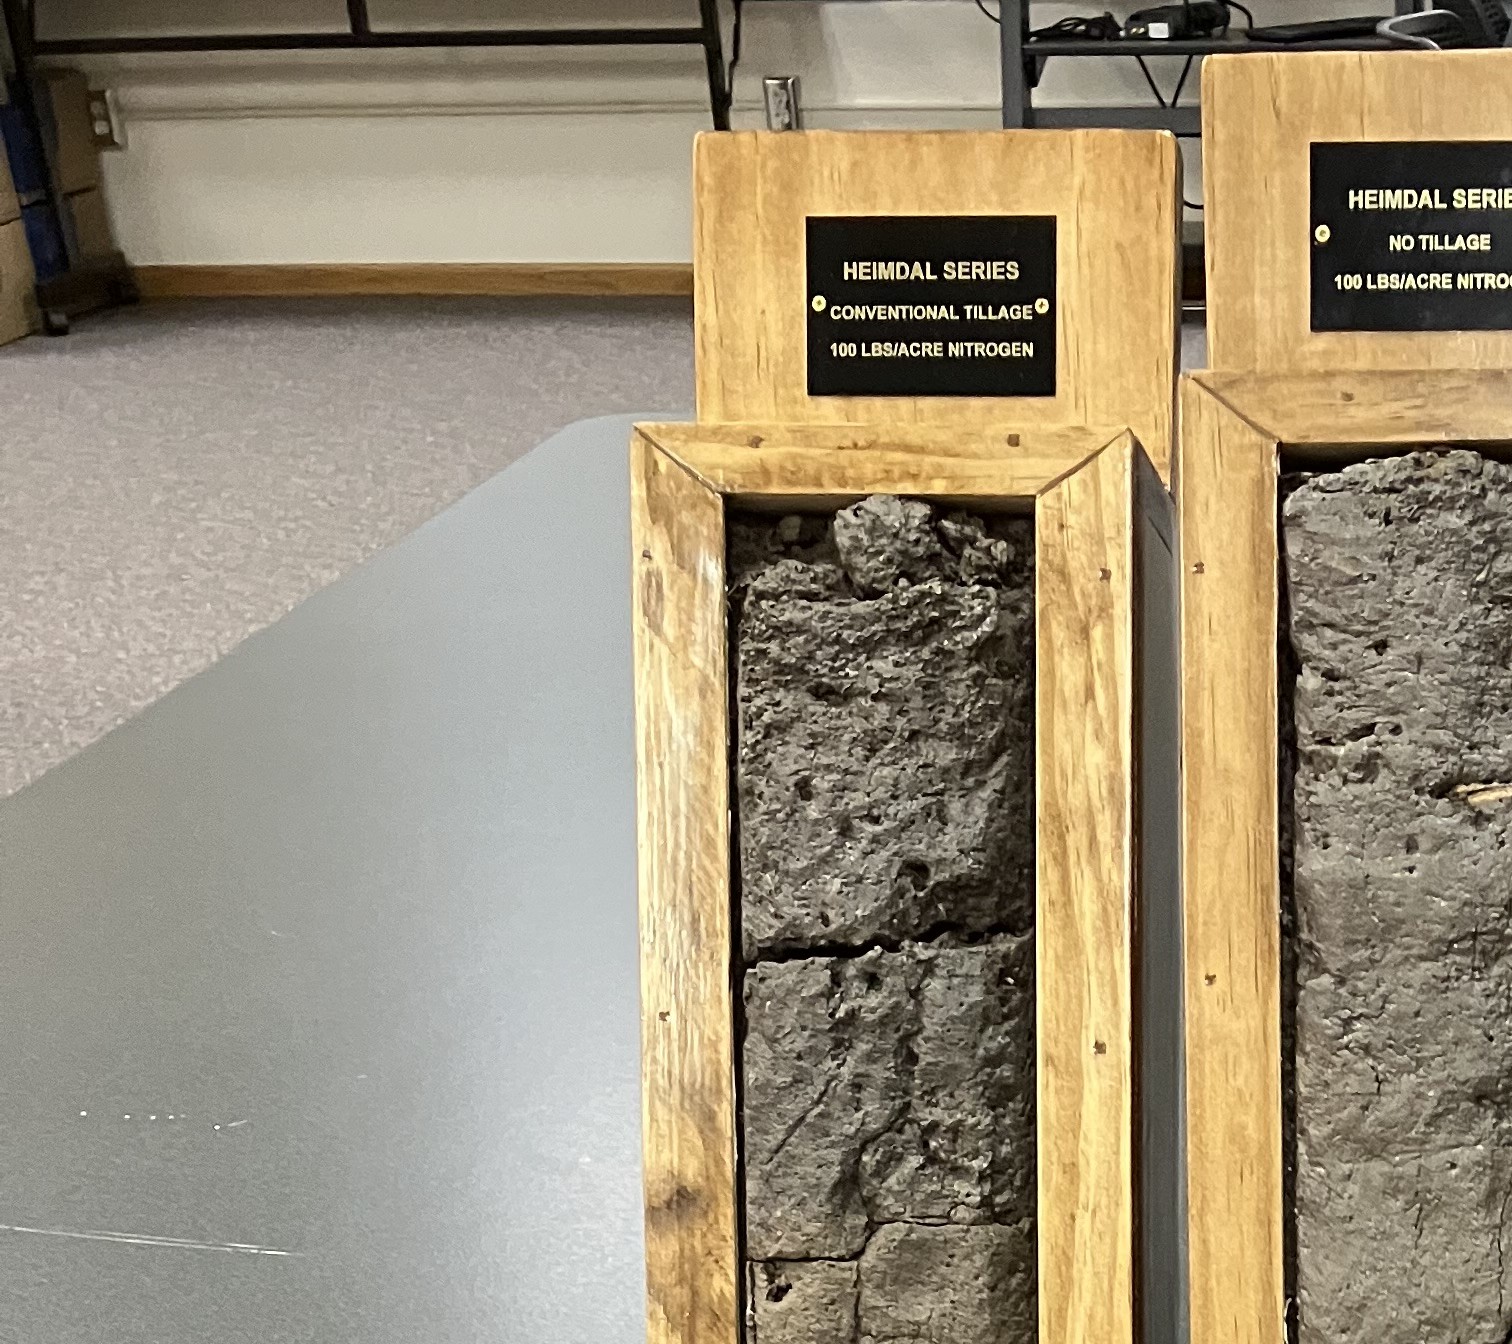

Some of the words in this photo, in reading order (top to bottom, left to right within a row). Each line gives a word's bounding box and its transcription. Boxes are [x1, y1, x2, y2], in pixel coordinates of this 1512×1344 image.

[1348, 188, 1448, 210] HEIMDAL
[1389, 234, 1415, 252] NO
[1417, 233, 1492, 251] TILLAGE
[843, 261, 938, 281] HEIMDAL
[943, 261, 1020, 280] SERIES
[1334, 273, 1363, 290] 100
[1366, 273, 1453, 290] LBS/ACRE
[830, 305, 960, 320] CONVENTIONAL
[962, 304, 1033, 320] TILLAGE
[830, 342, 857, 357] 100
[861, 342, 944, 357] LBS/ACRE
[948, 342, 1034, 358] NITROGEN
